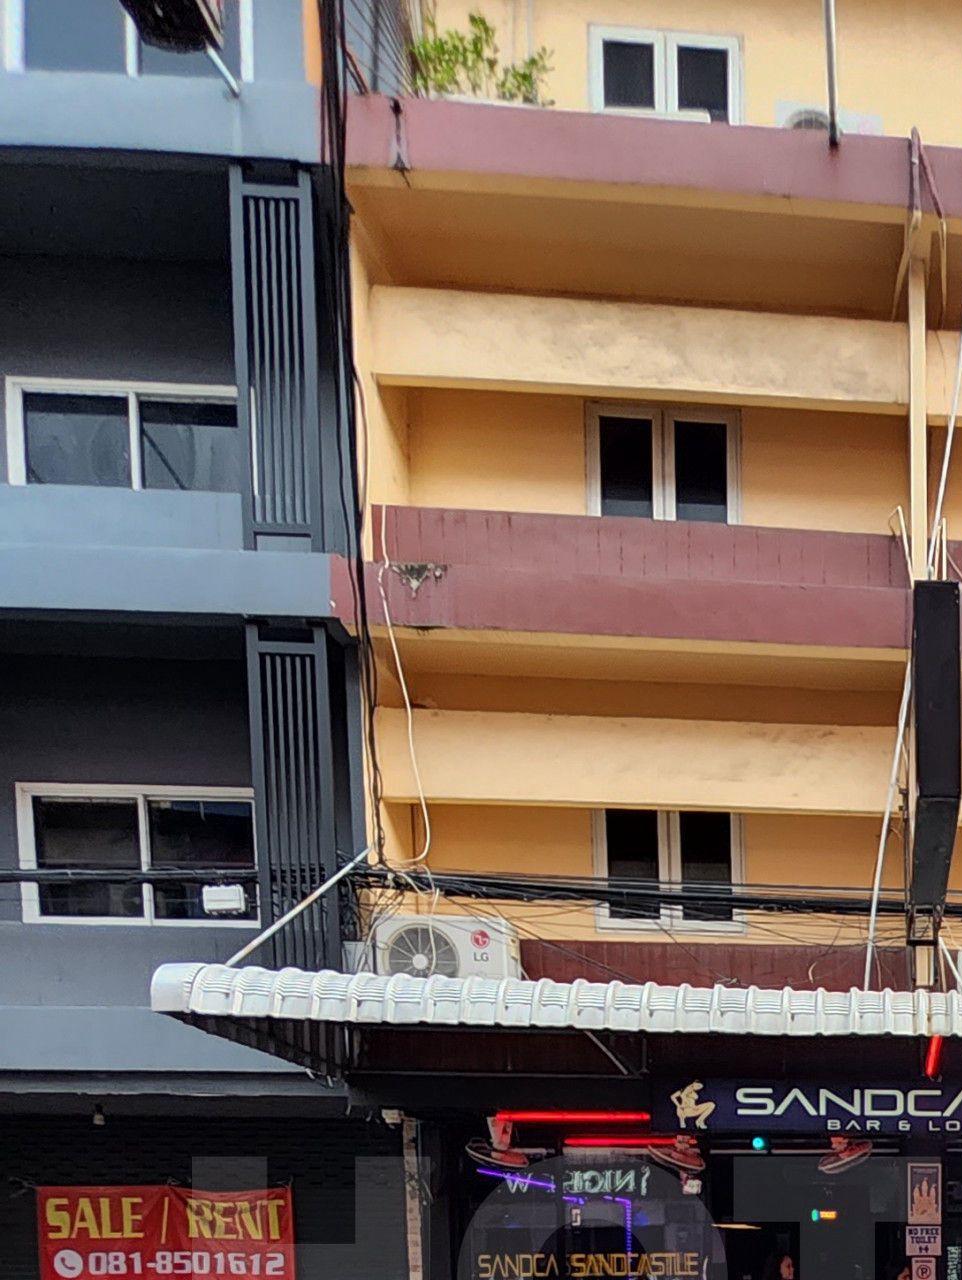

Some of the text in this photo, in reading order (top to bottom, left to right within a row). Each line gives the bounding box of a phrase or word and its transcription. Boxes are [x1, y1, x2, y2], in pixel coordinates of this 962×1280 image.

[473, 952, 489, 962] LG
[827, 1119, 881, 1132] BAR
[898, 1120, 911, 1131] &
[45, 1196, 285, 1245] SALE / RENT
[908, 1227, 940, 1236] NO FREE
[910, 1236, 937, 1244] TOILET
[88, 1251, 285, 1276] 081-8501612
